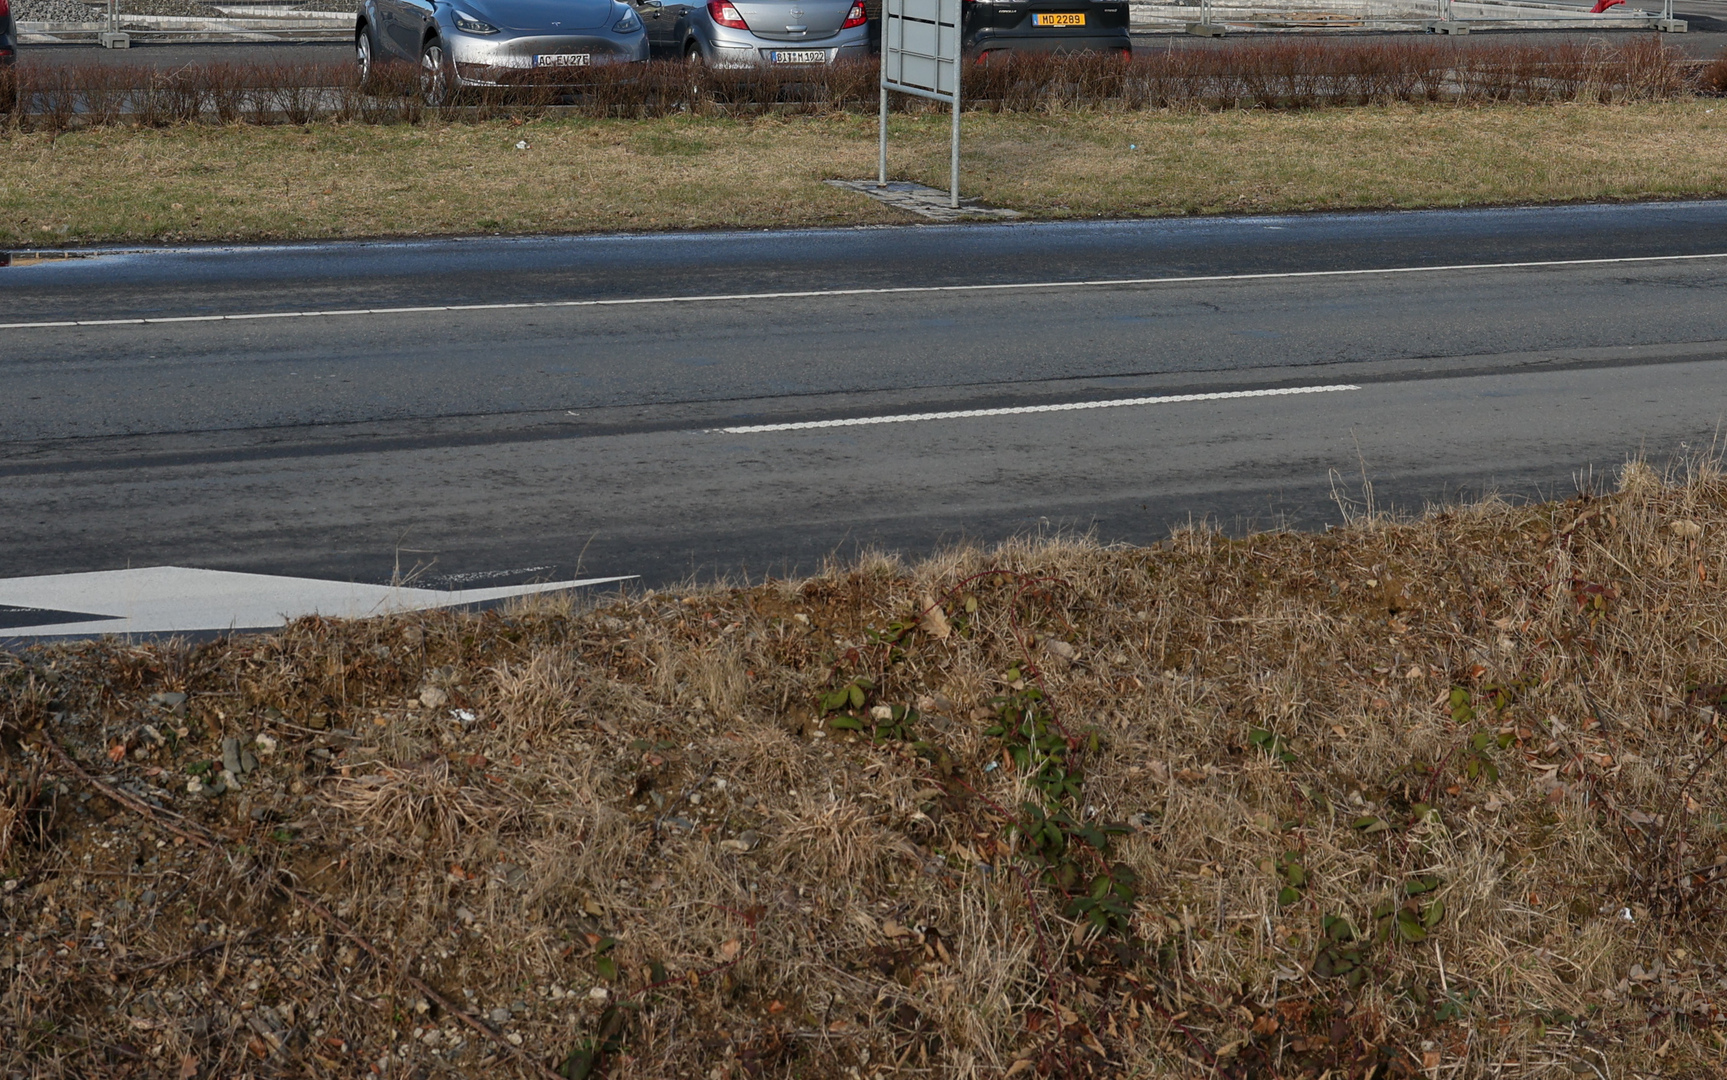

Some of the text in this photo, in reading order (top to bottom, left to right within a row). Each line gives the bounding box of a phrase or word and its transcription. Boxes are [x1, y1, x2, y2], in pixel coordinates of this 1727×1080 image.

[1042, 15, 1080, 24] MD 2289
[539, 56, 551, 66] AC
[777, 52, 792, 62] BIT
[797, 52, 803, 62] M
